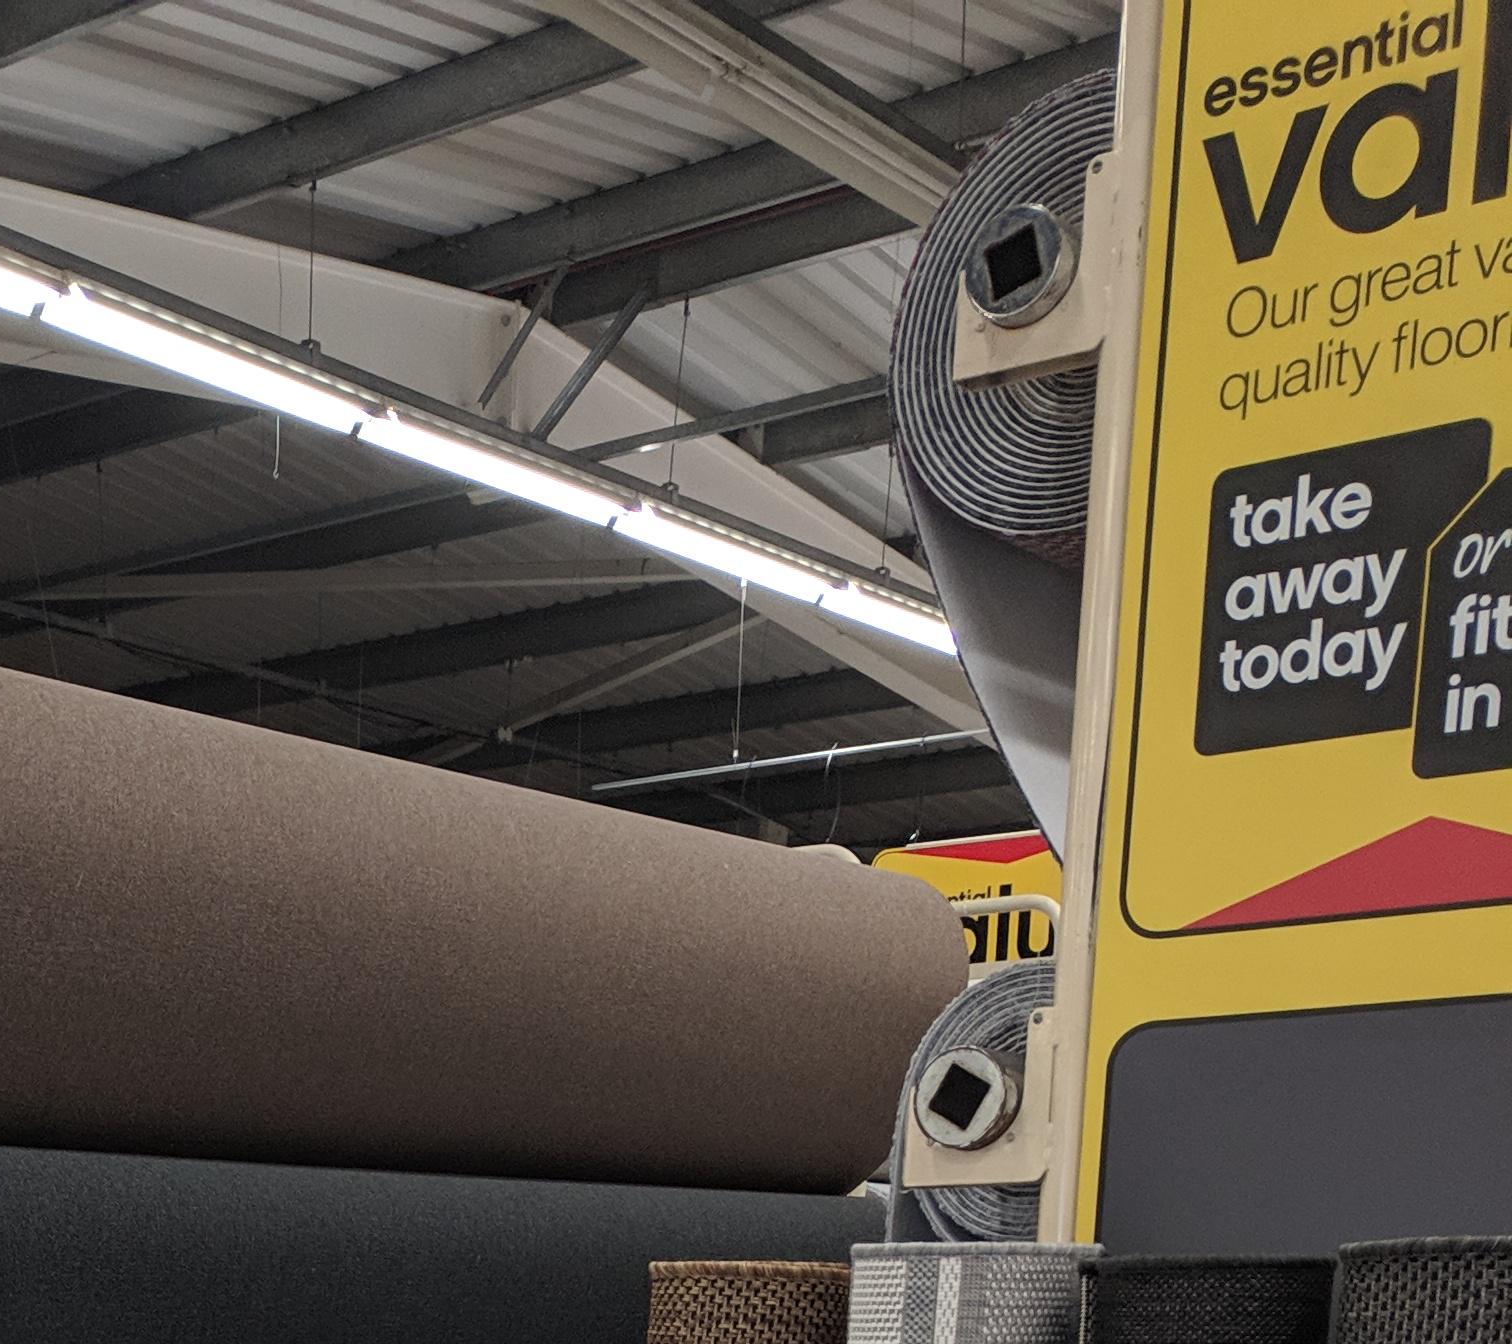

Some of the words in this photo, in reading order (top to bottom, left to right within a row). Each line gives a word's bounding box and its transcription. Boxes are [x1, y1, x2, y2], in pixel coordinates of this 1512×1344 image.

[1204, 0, 1463, 117] essential
[1226, 282, 1318, 338] Our
[1329, 240, 1461, 327] great
[1219, 337, 1380, 420] quality
[1230, 472, 1373, 547] take
[1224, 548, 1408, 621] away
[1220, 617, 1408, 692] today
[1444, 673, 1502, 734] in
